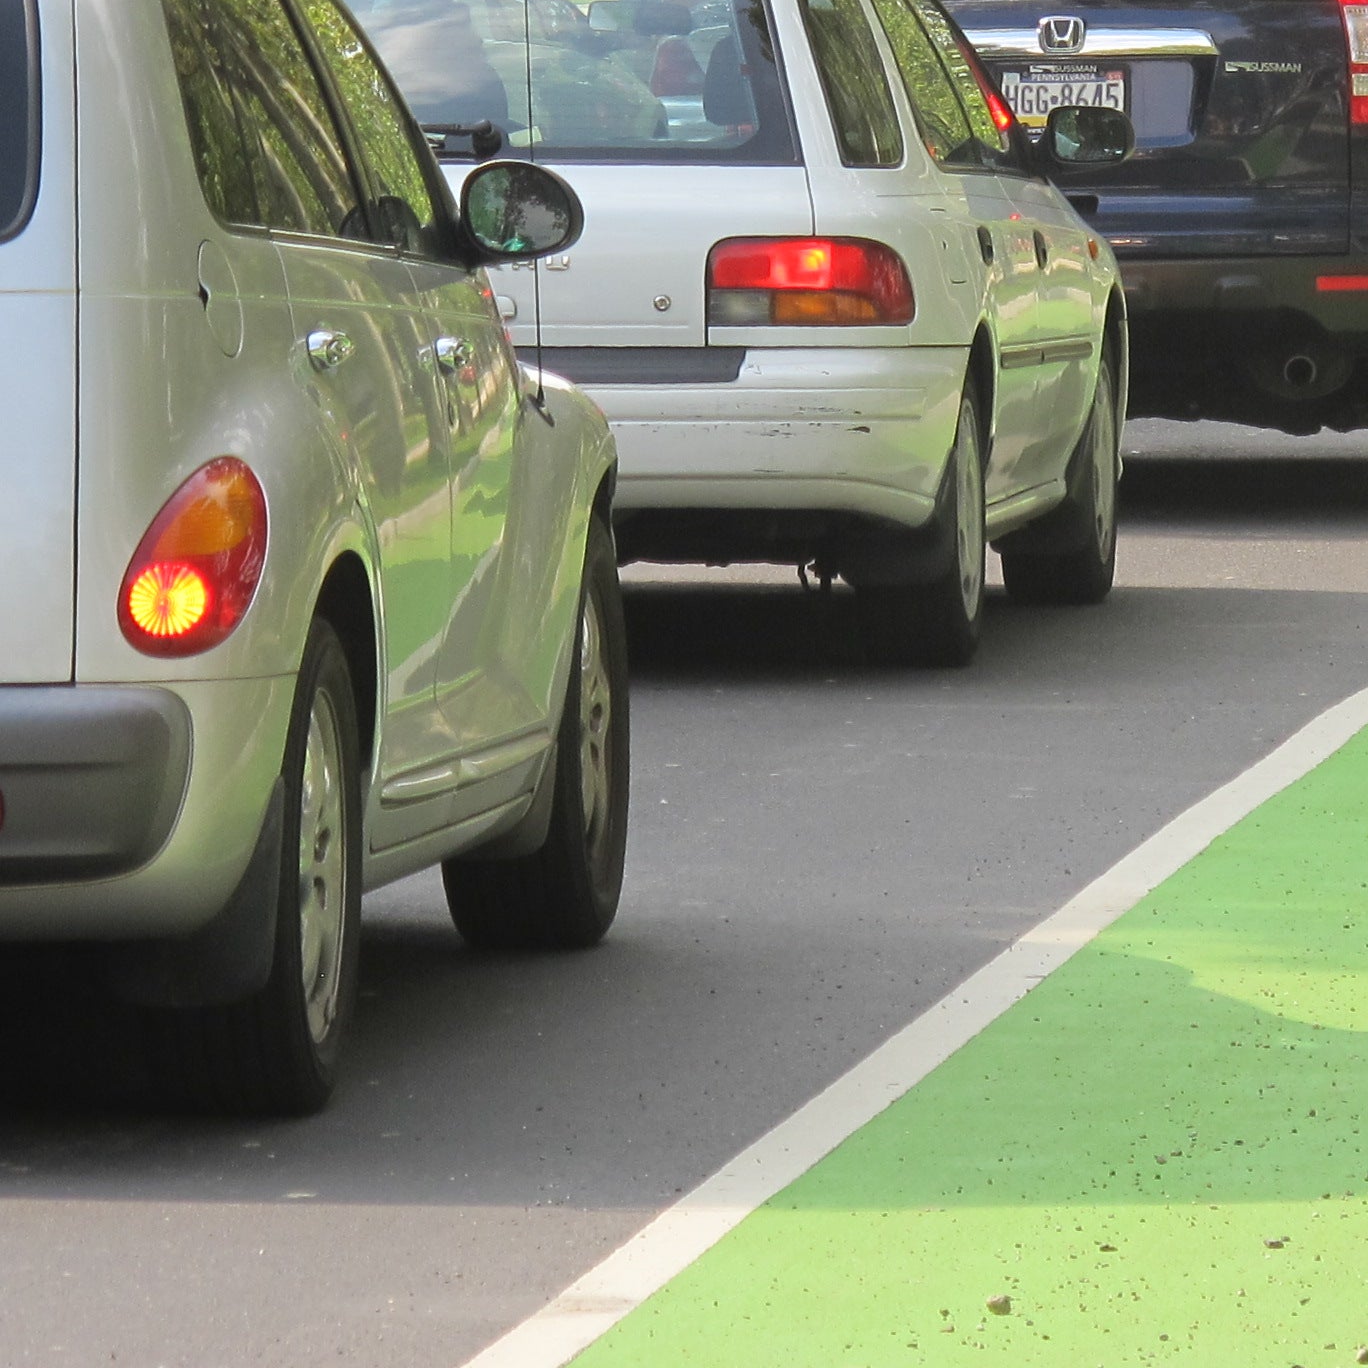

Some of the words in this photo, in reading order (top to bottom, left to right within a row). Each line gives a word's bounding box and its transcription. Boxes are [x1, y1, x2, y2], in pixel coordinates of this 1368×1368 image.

[1053, 64, 1098, 73] SUSSMAN
[1252, 62, 1302, 73] SUSSMAN
[1031, 72, 1097, 82] PENNSYLVANIA
